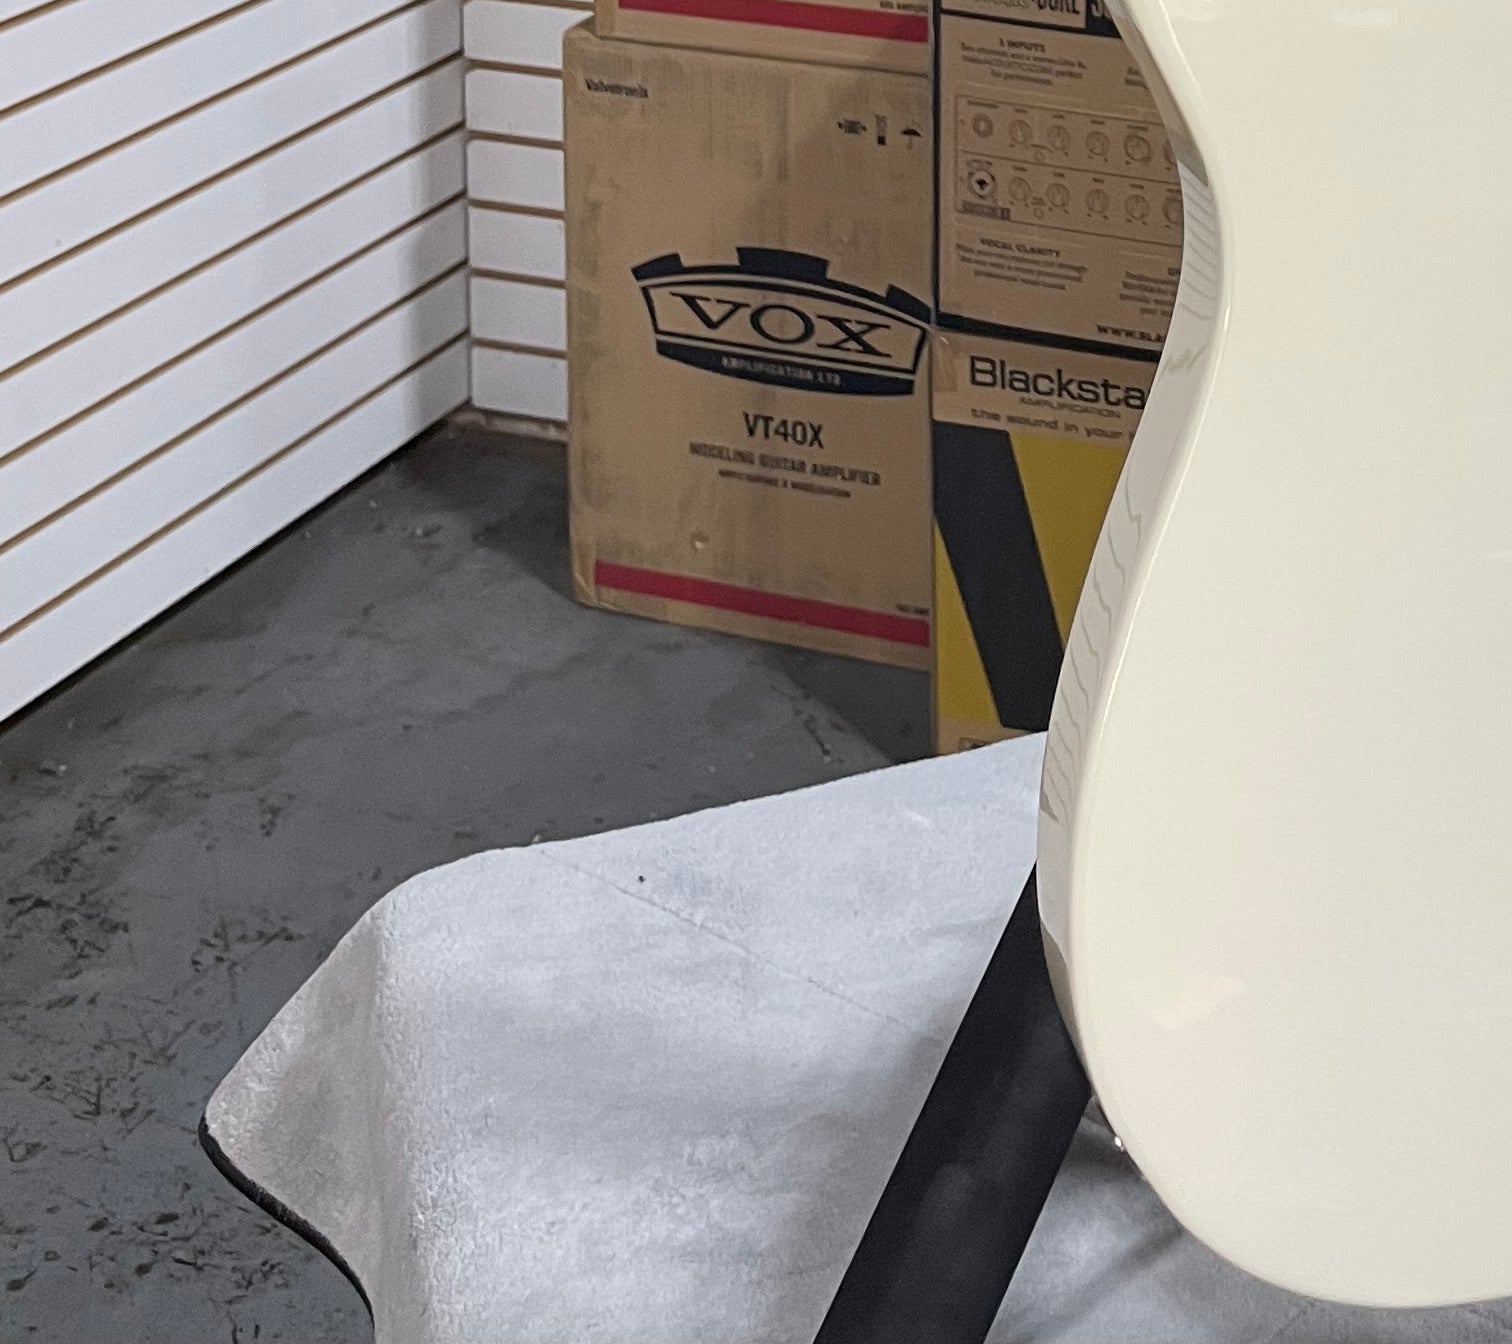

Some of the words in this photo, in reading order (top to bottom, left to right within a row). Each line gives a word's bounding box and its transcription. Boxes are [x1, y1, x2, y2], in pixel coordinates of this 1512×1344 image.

[669, 291, 893, 359] VOX
[969, 355, 1148, 411] Blacksta
[742, 411, 826, 450] VT40X
[971, 409, 1001, 422] the
[1007, 416, 1059, 431] sound
